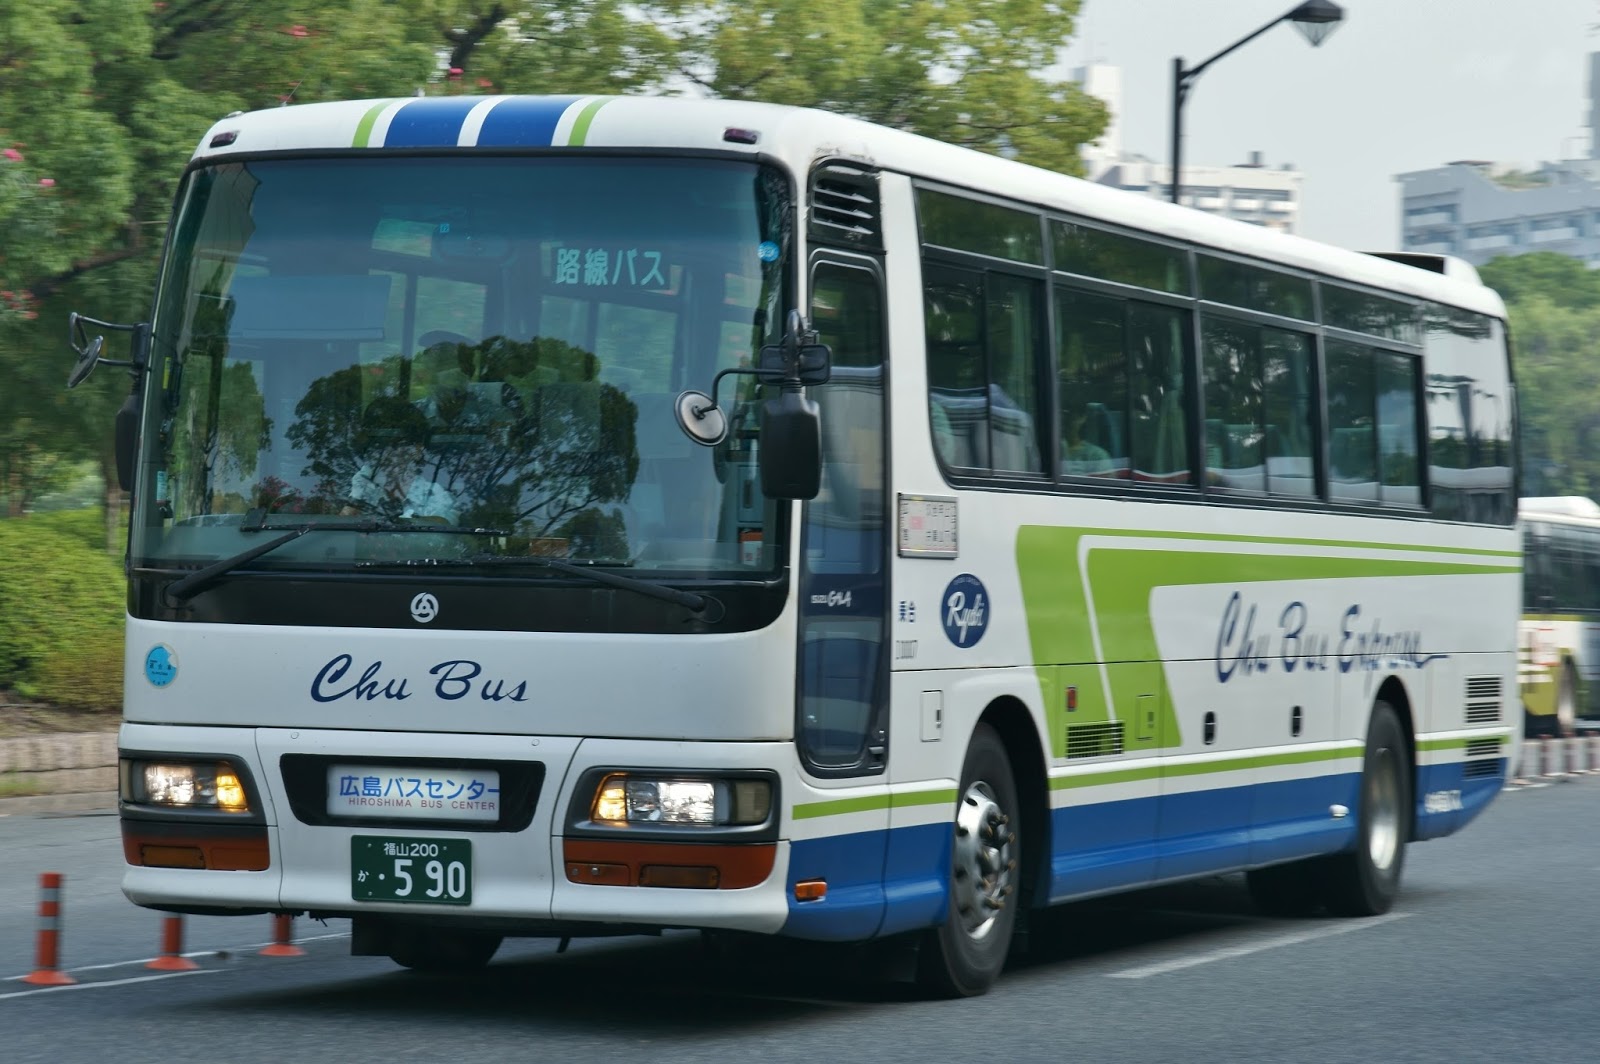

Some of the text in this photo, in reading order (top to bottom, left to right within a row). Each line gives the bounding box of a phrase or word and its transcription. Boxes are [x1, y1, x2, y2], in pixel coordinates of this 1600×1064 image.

[555, 248, 665, 286] 路線バス
[1216, 591, 1271, 683] Chu
[1279, 601, 1328, 673] Bus
[310, 653, 530, 702] Chu Bus
[339, 775, 499, 801] 広島バスセンター
[348, 798, 496, 811] HIROSHIMA BUS CENTER
[383, 842, 439, 857] 福山200
